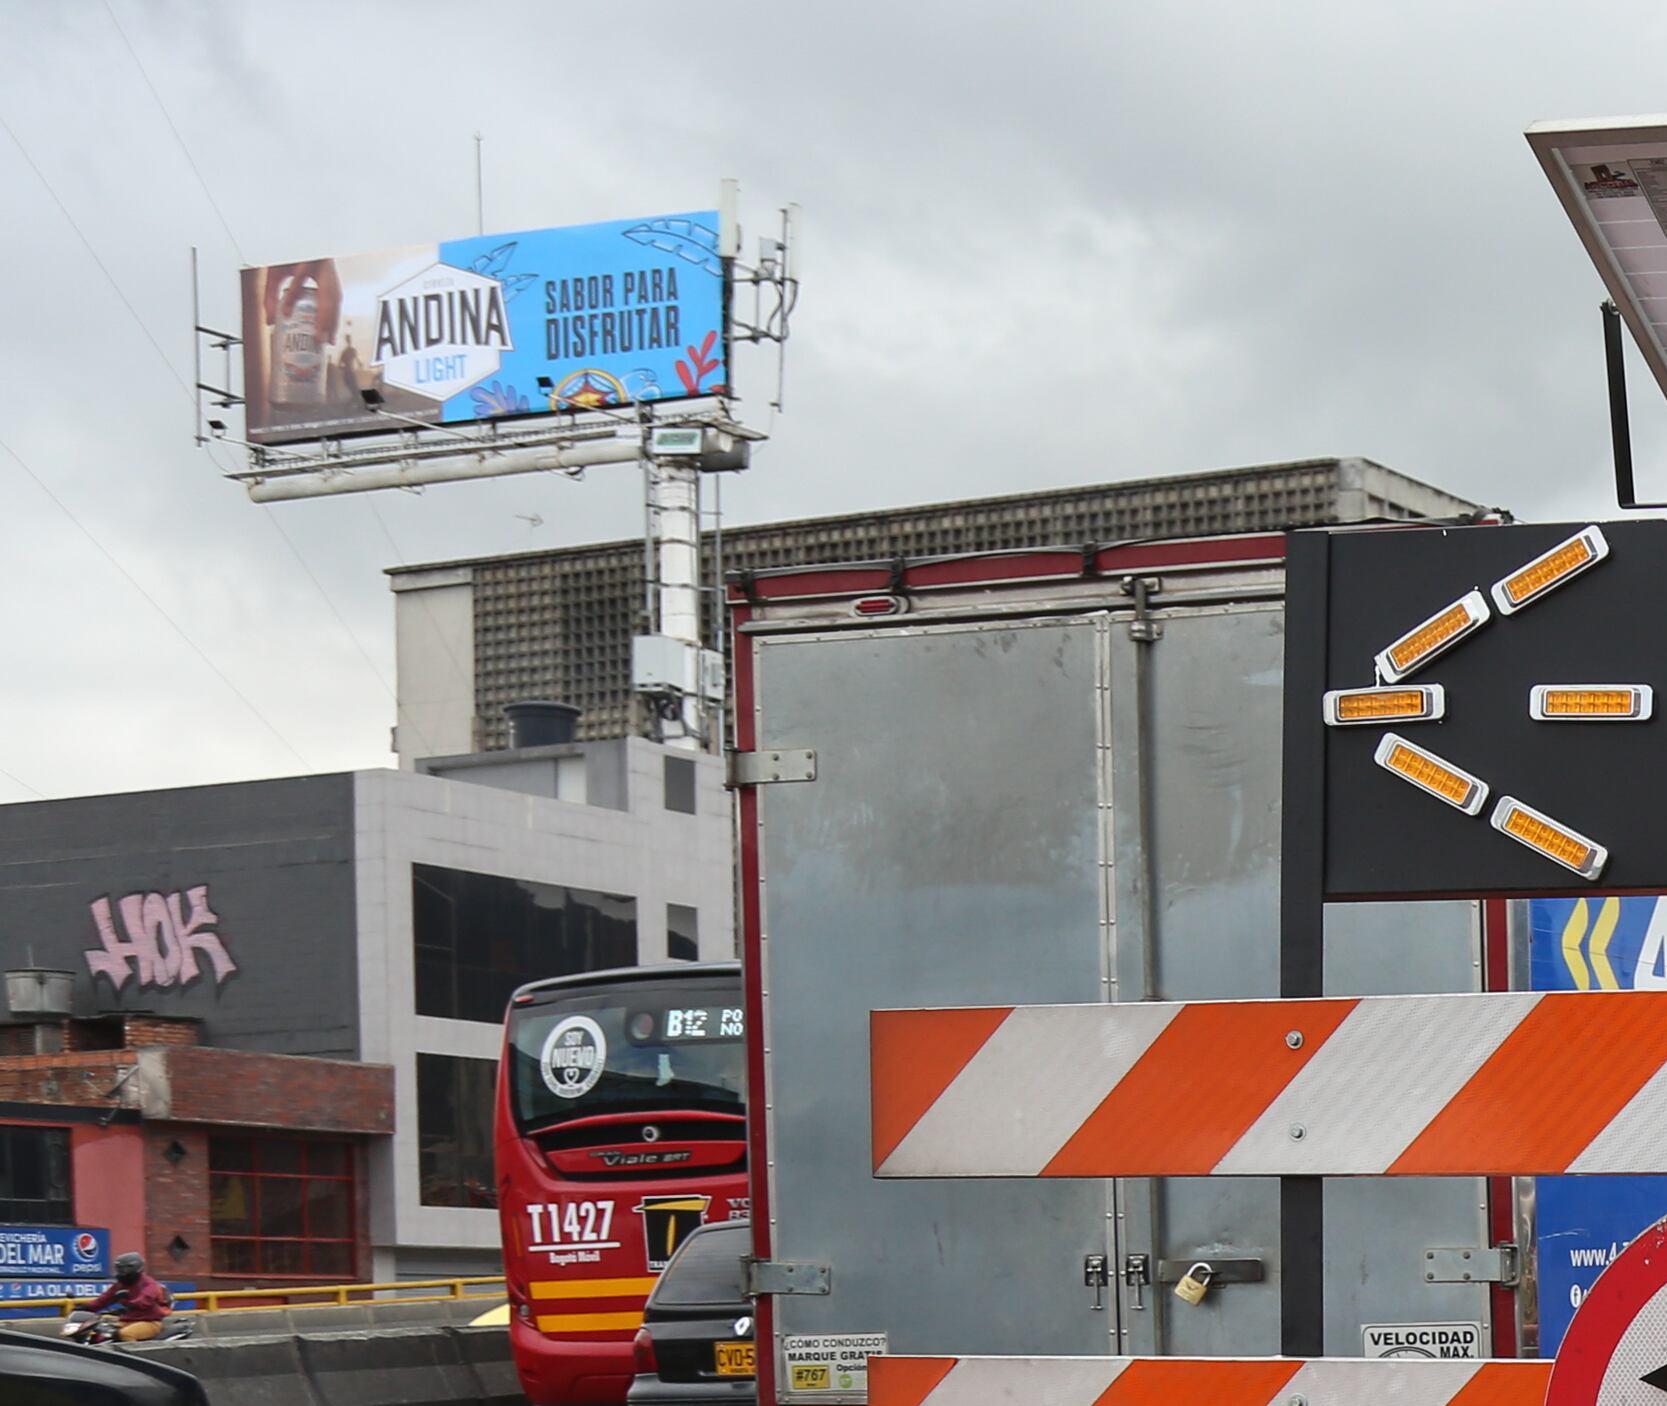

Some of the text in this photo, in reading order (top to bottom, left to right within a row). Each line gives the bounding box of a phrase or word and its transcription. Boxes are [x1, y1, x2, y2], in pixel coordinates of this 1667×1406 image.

[545, 266, 677, 314] SABOR PARA
[375, 286, 508, 362] ANDINA
[546, 305, 681, 360] DISFRUTAR
[415, 354, 467, 384] LIGHT
[667, 1009, 744, 1037] B12 PO
[720, 1023, 744, 1036] NO
[551, 1046, 596, 1069] NUEVO
[526, 1201, 615, 1243] T1427
[29, 1244, 65, 1265] MAR
[28, 1284, 48, 1297] LA
[823, 1337, 887, 1348] CONDUZCO?
[1370, 1331, 1475, 1345] VELOCIDAD
[788, 1351, 838, 1362] MARQUE
[795, 1369, 827, 1382] #767
